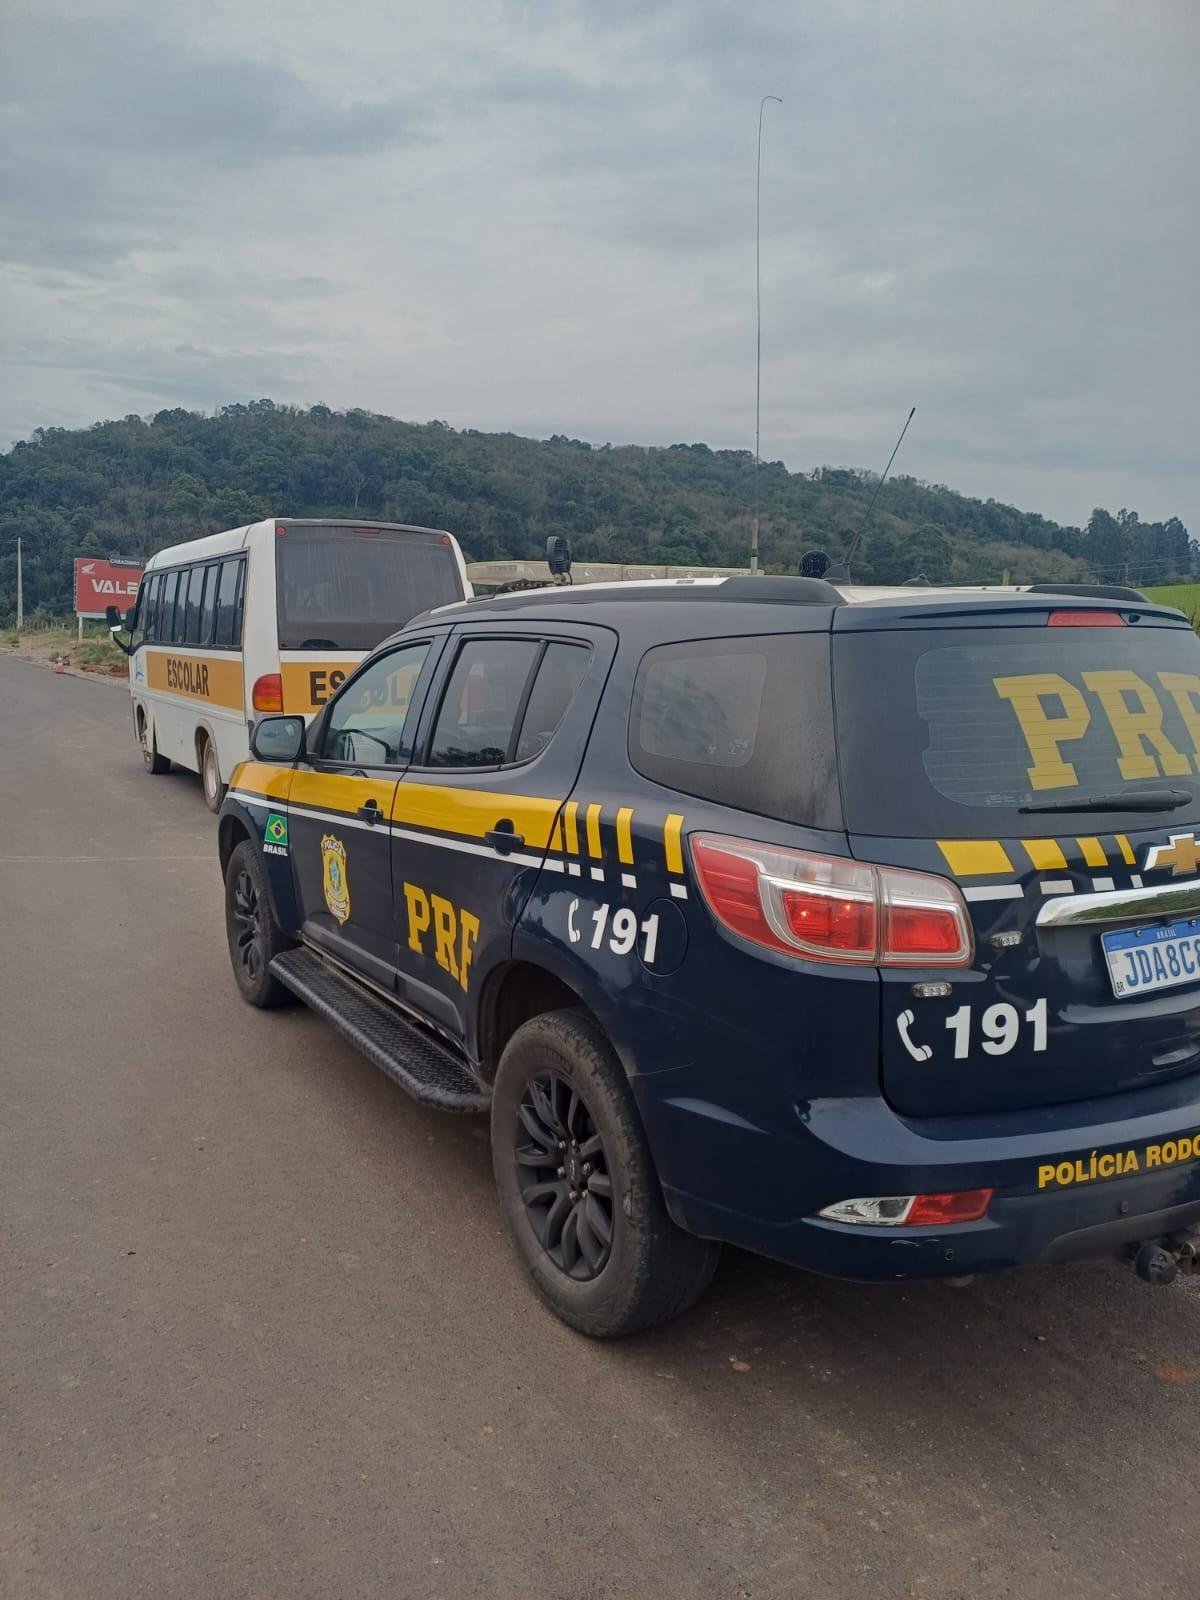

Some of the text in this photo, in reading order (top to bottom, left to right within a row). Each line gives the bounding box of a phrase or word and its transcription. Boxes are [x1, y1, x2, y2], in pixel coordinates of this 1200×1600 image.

[91, 579, 138, 594] VALE
[167, 658, 209, 696] ESCOLAR
[263, 844, 288, 856] BRASIL
[403, 881, 480, 993] PRF
[591, 903, 659, 963] 191
[945, 998, 1048, 1060] 191
[1038, 1150, 1139, 1189] POLÍCIA
